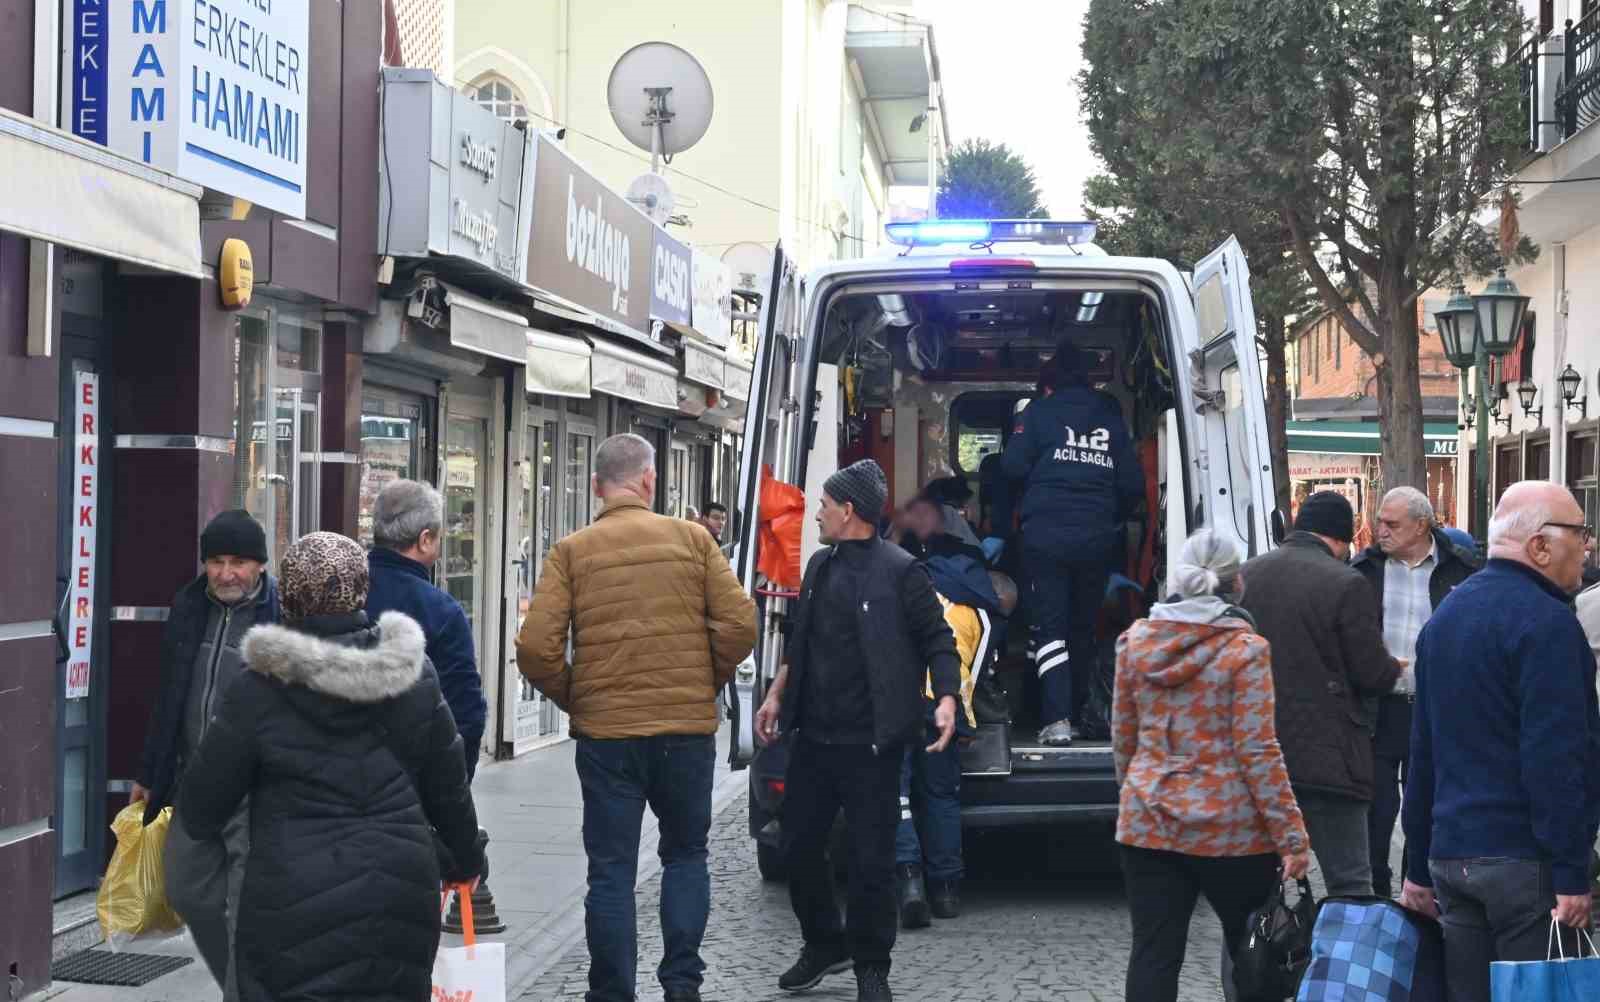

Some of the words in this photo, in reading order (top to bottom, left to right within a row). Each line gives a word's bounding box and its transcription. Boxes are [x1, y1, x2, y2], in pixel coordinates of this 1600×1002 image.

[194, 0, 300, 95] ERKEKLER
[192, 65, 299, 164] HAMAMI
[566, 174, 630, 311] bozkaya
[655, 245, 688, 311] CASIO
[1065, 426, 1109, 451] 112
[75, 383, 94, 648] ERKEKLERE
